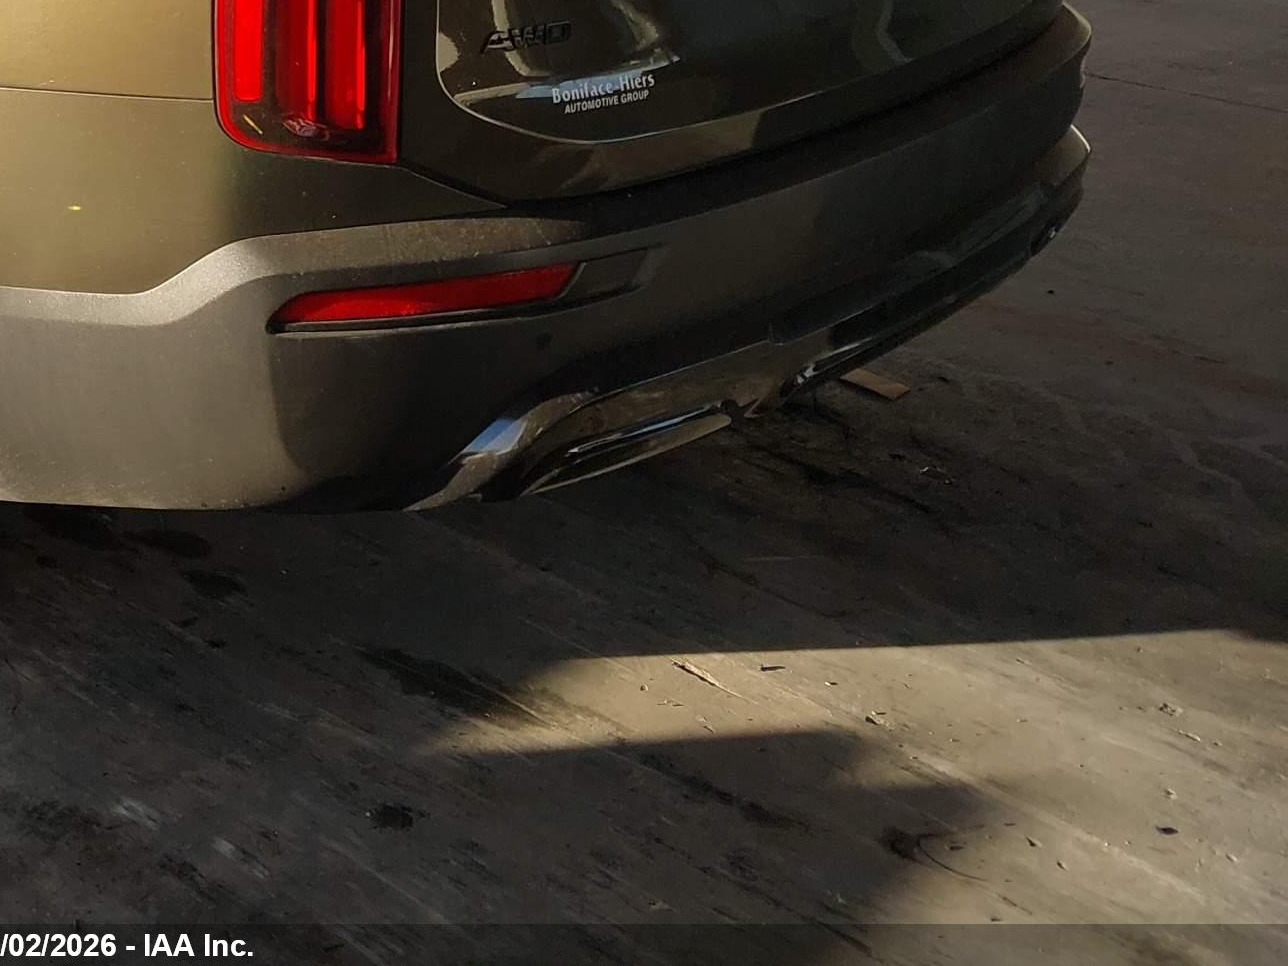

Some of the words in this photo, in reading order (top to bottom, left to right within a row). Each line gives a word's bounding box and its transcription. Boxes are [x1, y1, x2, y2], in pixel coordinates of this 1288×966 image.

[551, 74, 656, 104] Boniface-Hiers
[564, 94, 620, 115] AUTOMOTIVE
[619, 89, 651, 105] GROUP
